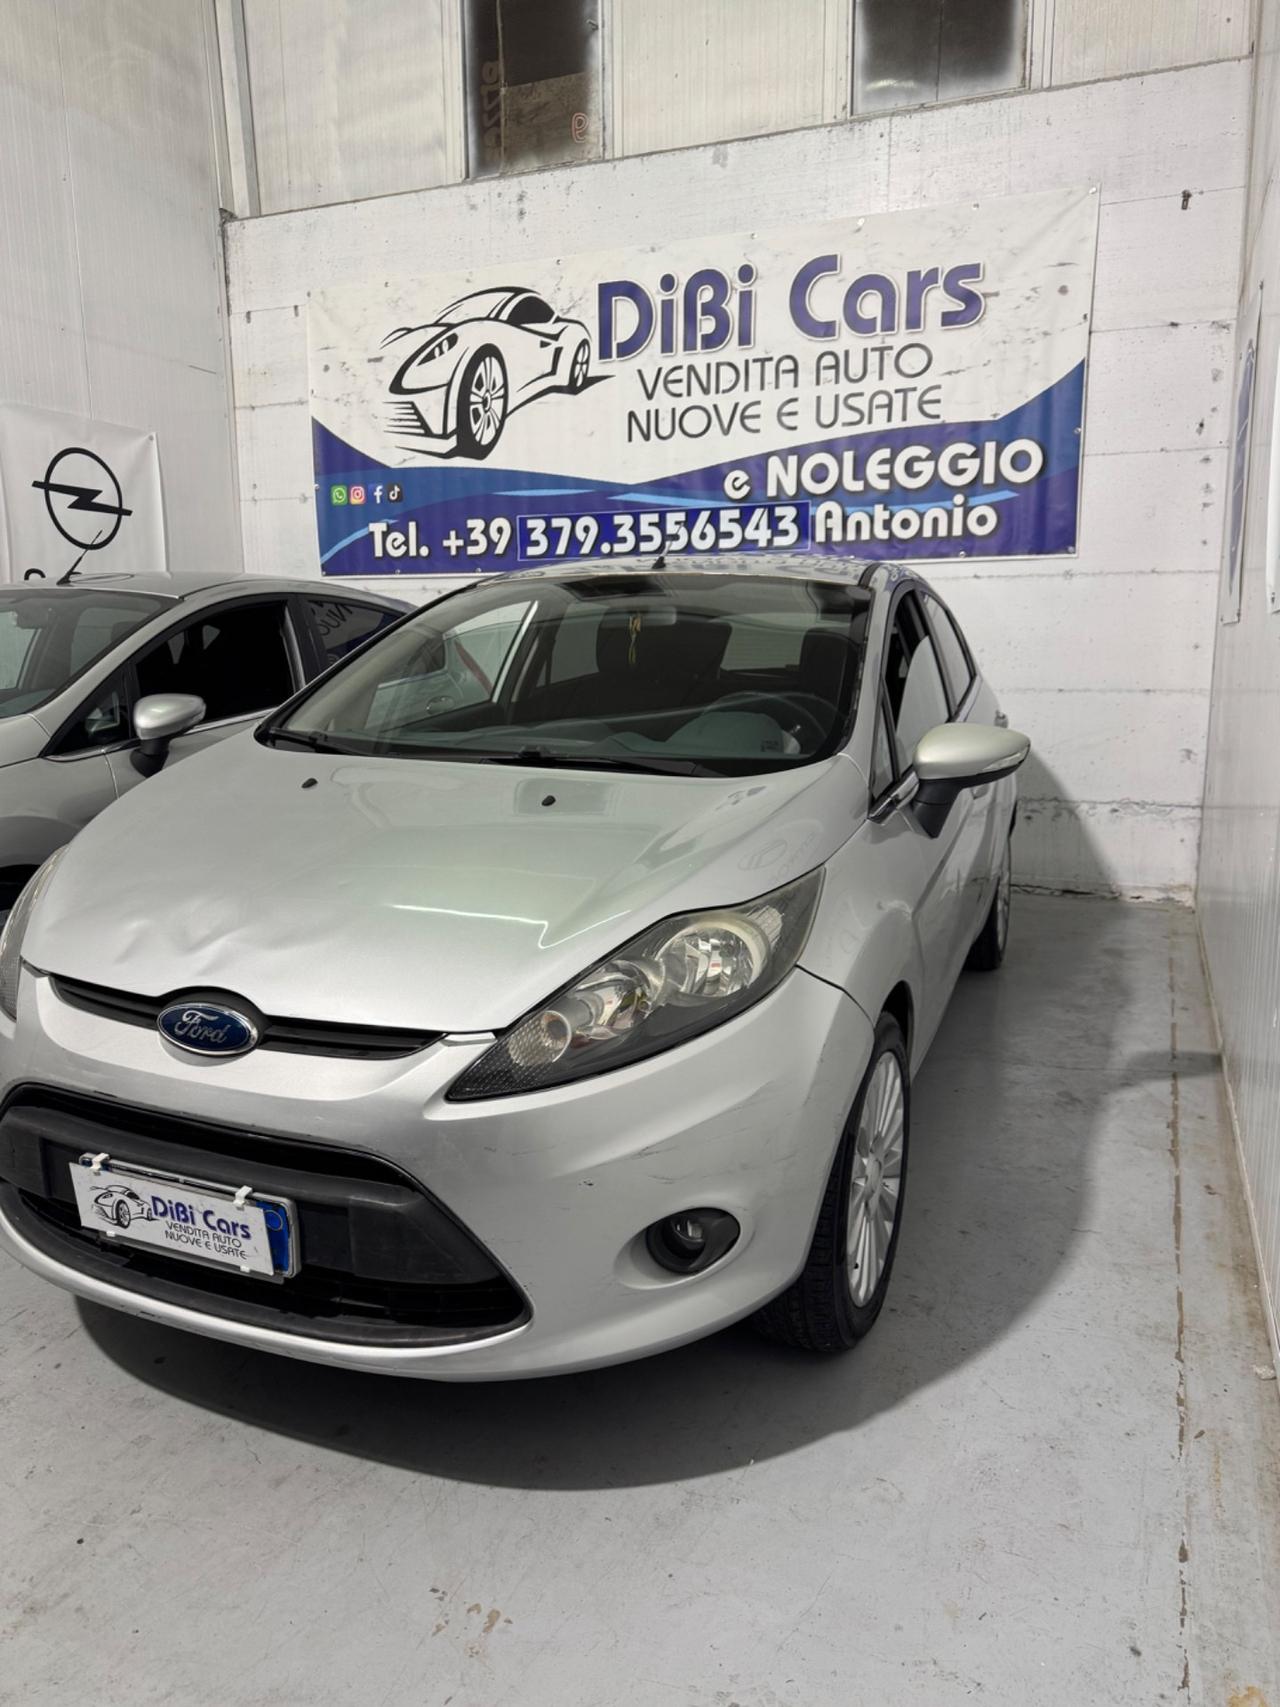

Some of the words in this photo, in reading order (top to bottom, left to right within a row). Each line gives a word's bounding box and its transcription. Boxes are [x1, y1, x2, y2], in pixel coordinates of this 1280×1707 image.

[789, 253, 985, 341] Cars
[637, 354, 799, 401] VENDITA
[815, 342, 933, 386] AUTO
[627, 400, 762, 443] NUOVE
[776, 397, 799, 431] E
[815, 384, 942, 430] USATE
[723, 469, 751, 499] e
[767, 438, 1044, 498] NOLEGGIO
[368, 521, 430, 558] Tel.
[442, 517, 512, 556] +39
[526, 505, 799, 556] 379.3556543
[815, 493, 998, 543] Antonio
[174, 1009, 231, 1044] Ford
[164, 1230, 203, 1248] NUOVE
[204, 1241, 212, 1251] E
[213, 1243, 248, 1260] USATE
[165, 1220, 210, 1240] VENDITA
[212, 1231, 242, 1249] AUTO
[202, 1209, 251, 1240] Cars
